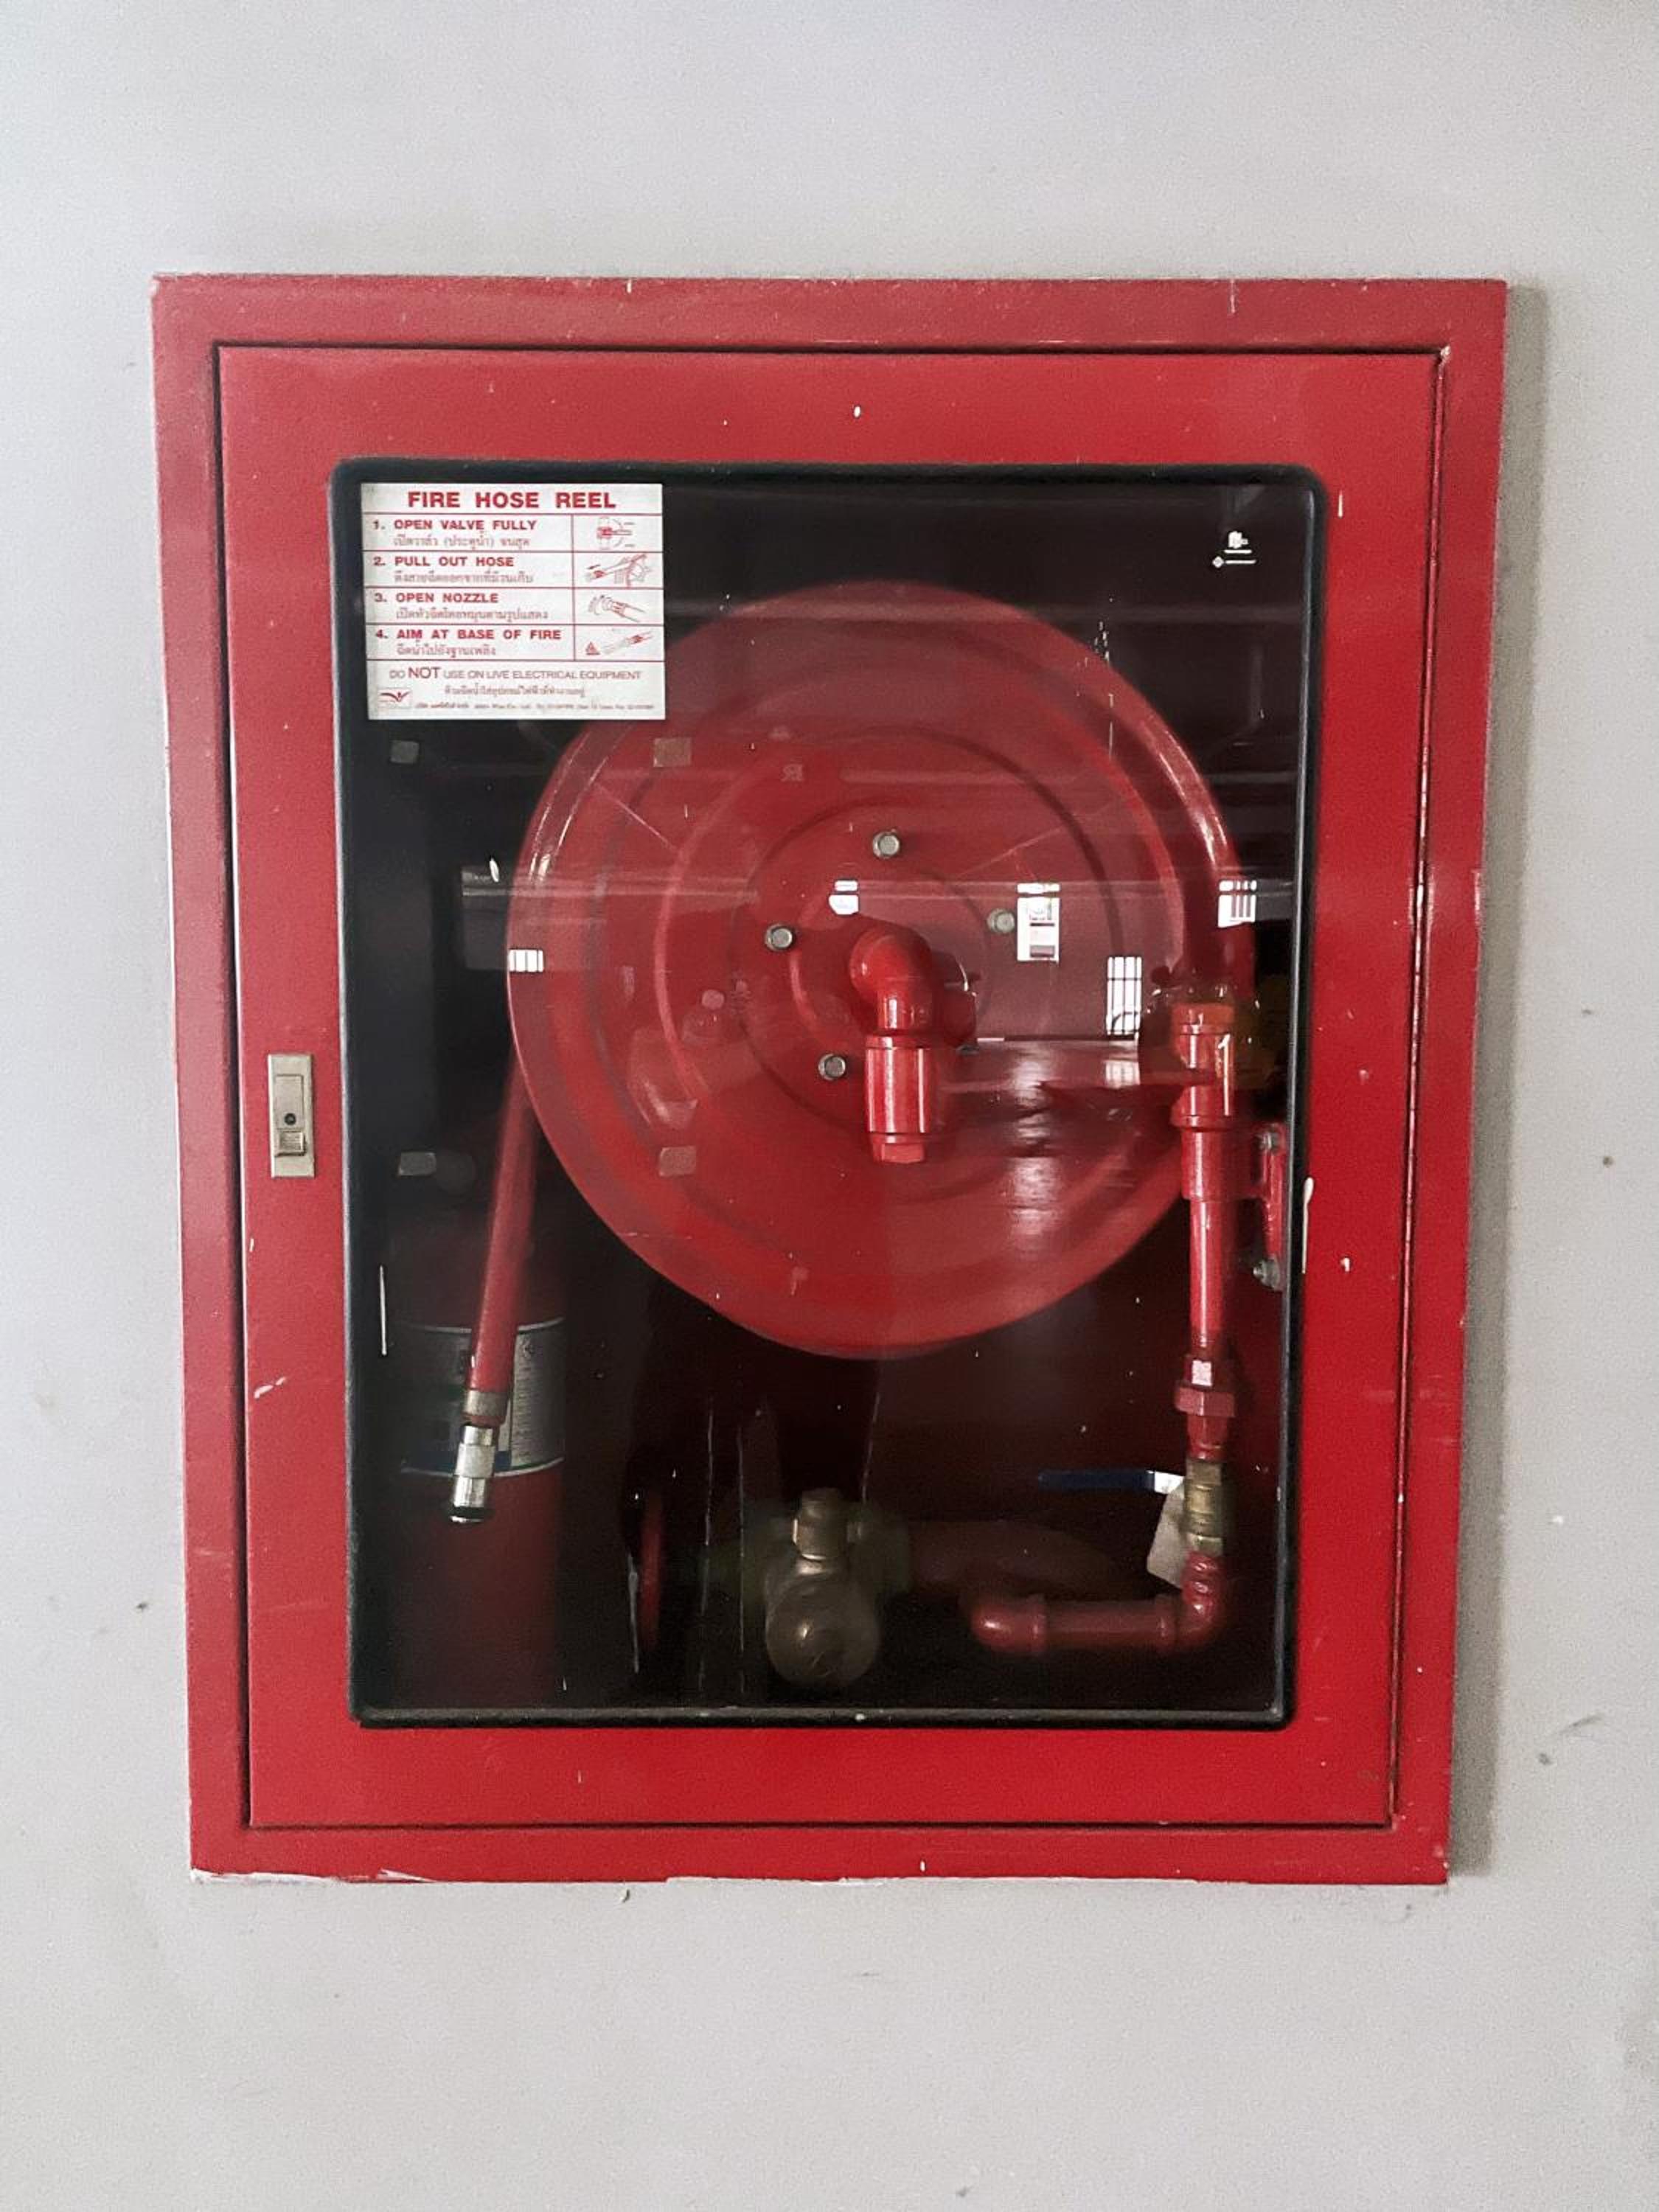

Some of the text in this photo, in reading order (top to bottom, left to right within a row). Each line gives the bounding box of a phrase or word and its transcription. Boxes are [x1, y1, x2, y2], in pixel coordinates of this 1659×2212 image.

[408, 492, 616, 508] FIRE HOSE REEL
[373, 520, 537, 530] 1. OPEN VALVE FULLY
[373, 557, 514, 567] 2. PULL OUT HOSE
[375, 593, 498, 603] 3. OPEN NOZZLE
[375, 630, 561, 639] 4. AIM AT BASE OF FIRE
[389, 667, 641, 680] DO NOT USE ON LIVE ELECTRICAL EQUIPMENT
